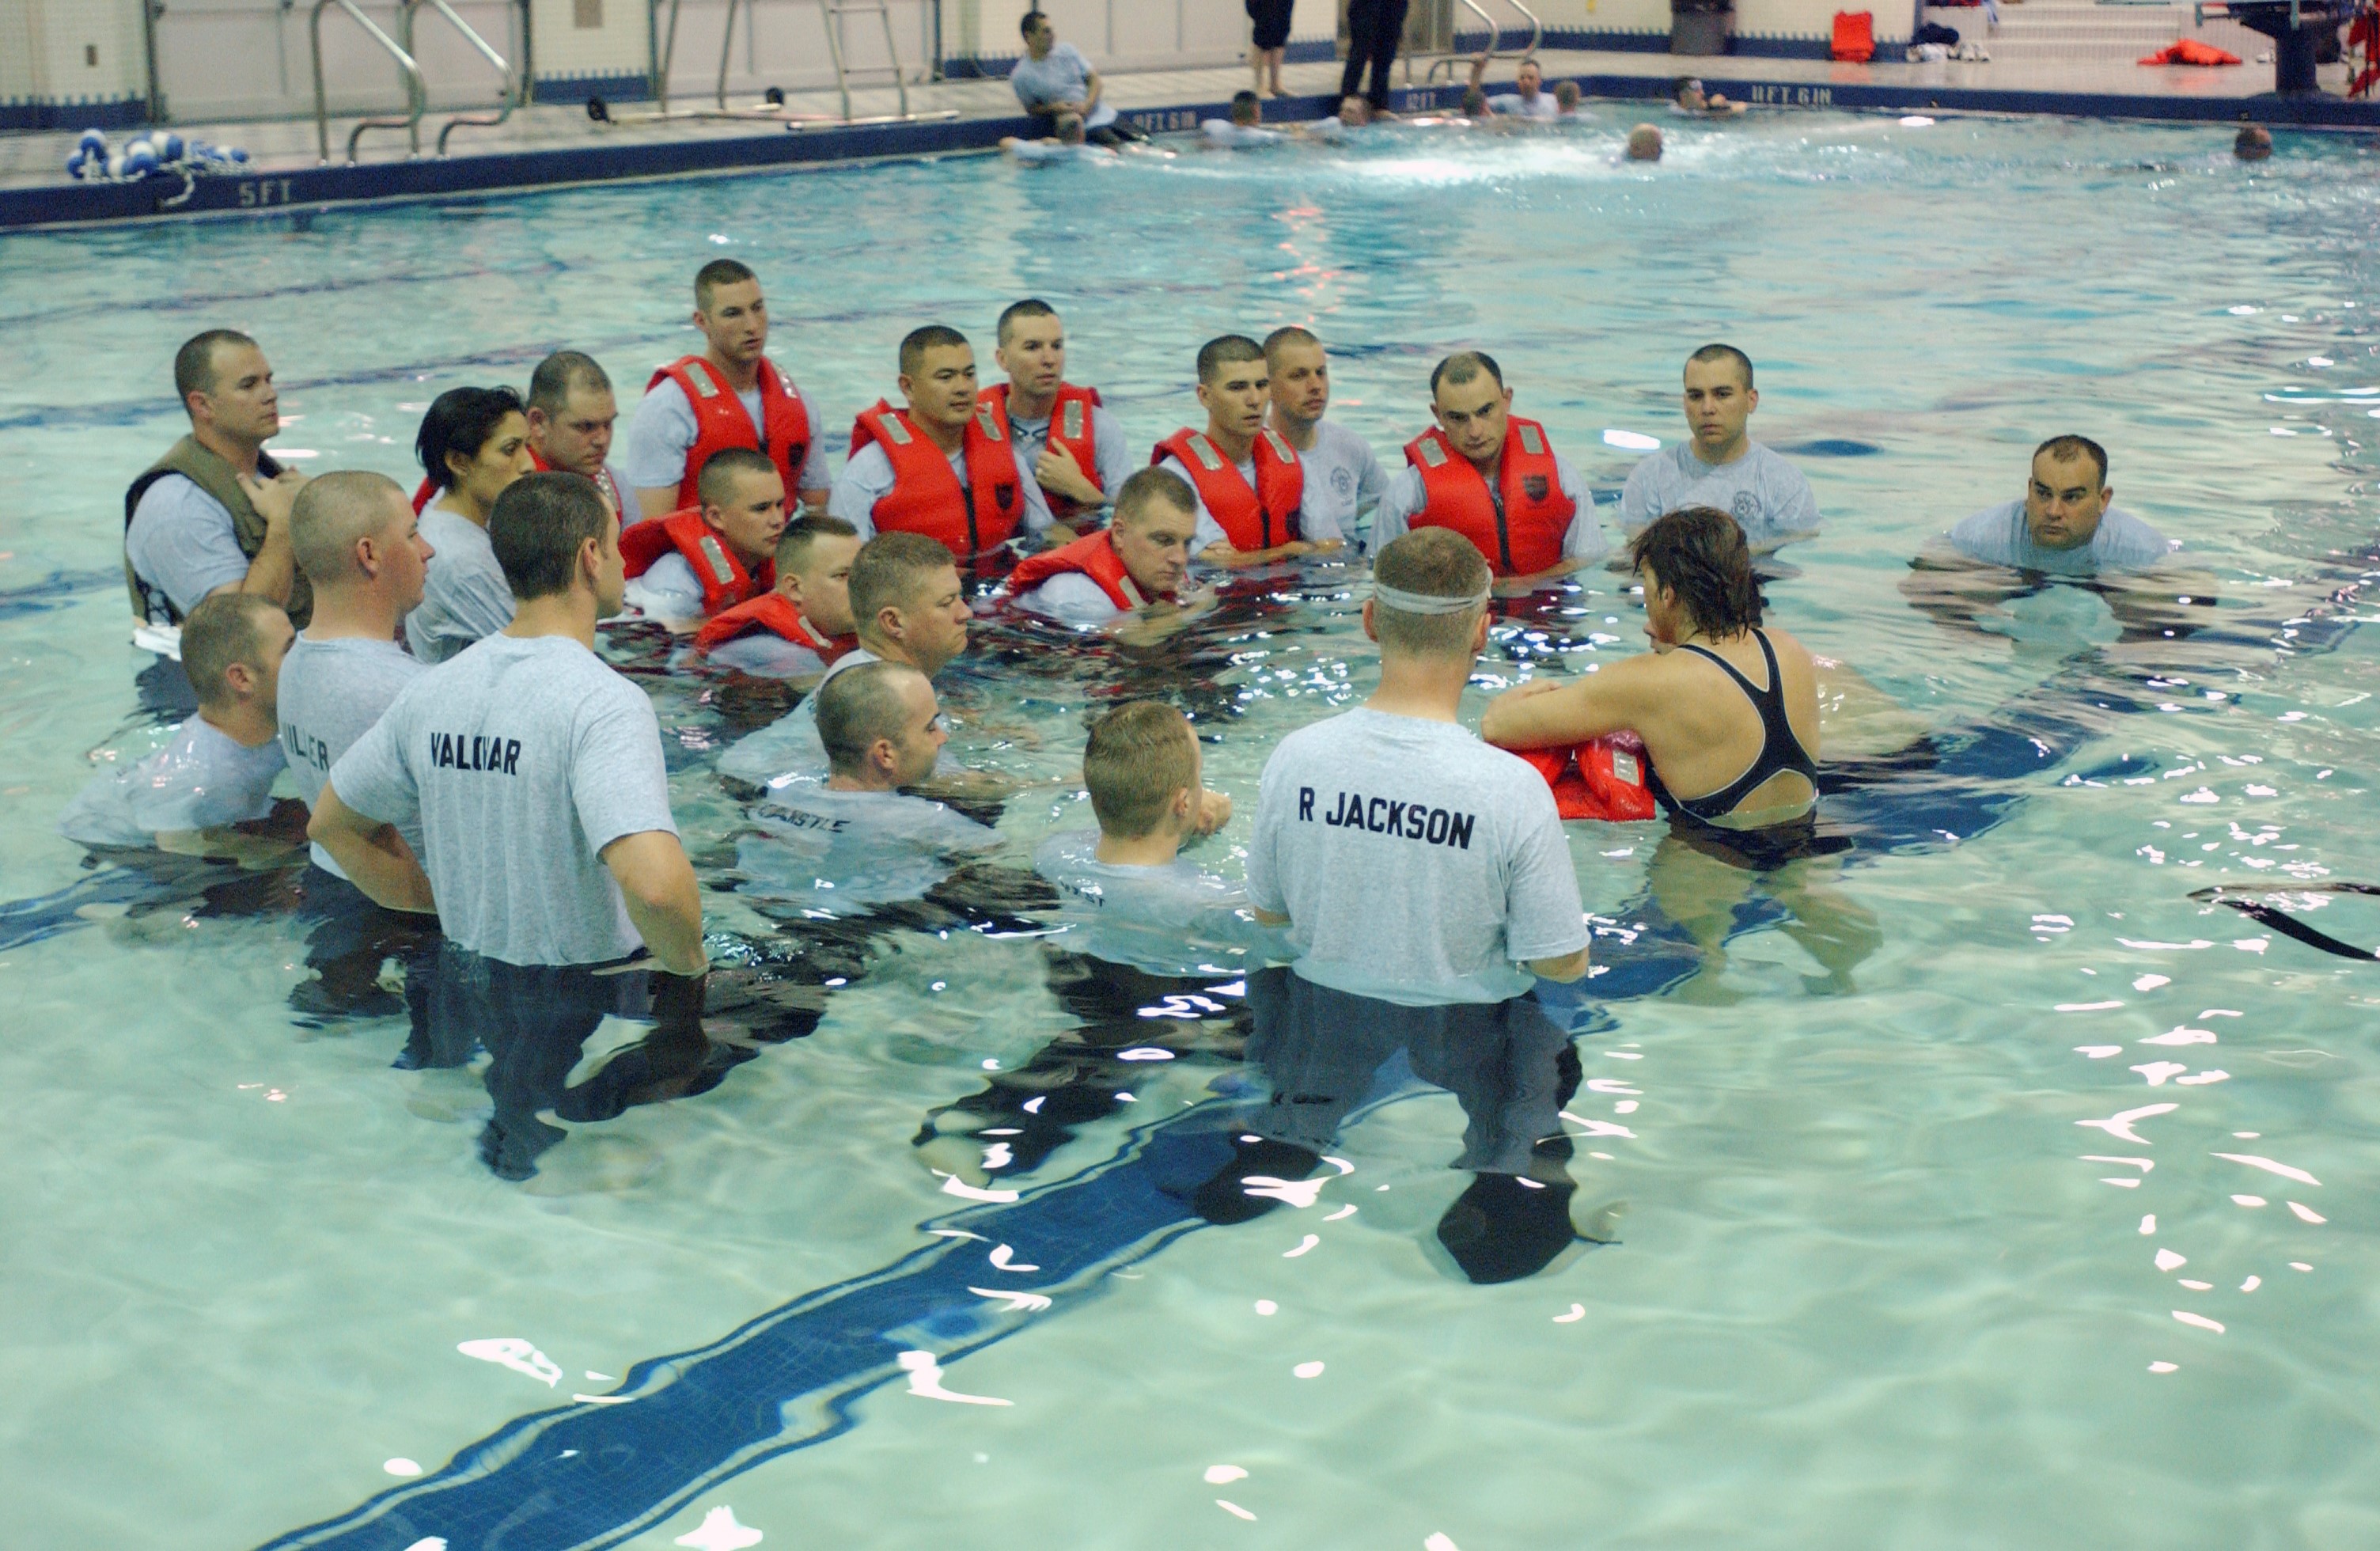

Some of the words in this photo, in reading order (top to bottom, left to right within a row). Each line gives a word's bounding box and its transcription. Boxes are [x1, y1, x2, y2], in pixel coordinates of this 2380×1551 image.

[282, 722, 330, 772] ILER
[1299, 787, 1315, 821] R
[1326, 791, 1476, 850] JACKSON
